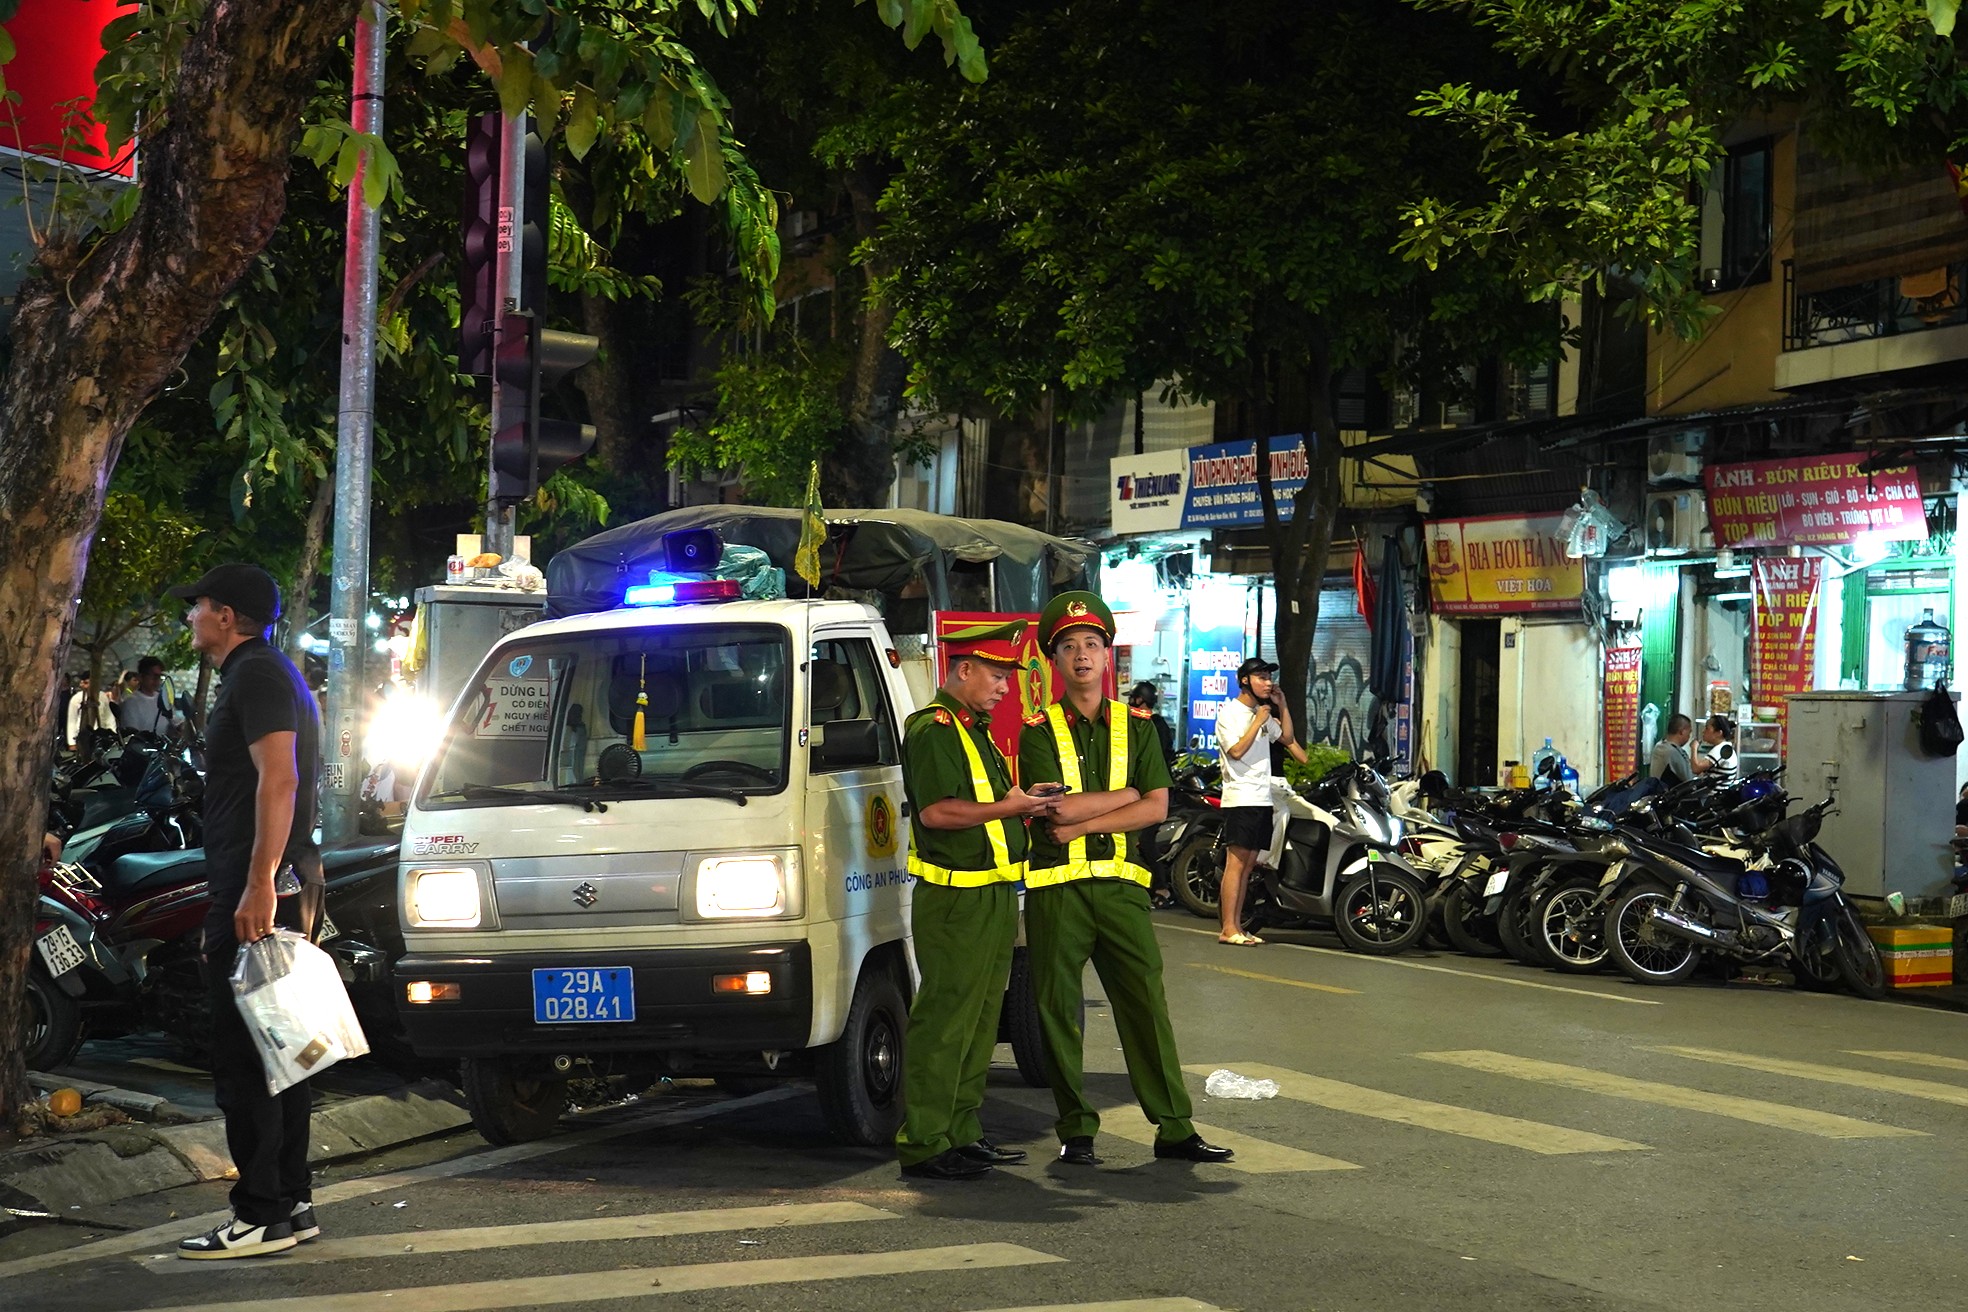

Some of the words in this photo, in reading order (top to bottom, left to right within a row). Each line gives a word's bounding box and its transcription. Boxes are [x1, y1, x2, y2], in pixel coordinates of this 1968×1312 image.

[1239, 442, 1257, 484] PHẨ
[1765, 466, 1799, 483] BÚN
[1803, 461, 1841, 481] RIÊU
[1885, 480, 1904, 501] CHẢ
[1905, 481, 1918, 499] CÁ
[1713, 494, 1742, 516] BÚN
[1745, 491, 1778, 515] RIÊU
[1815, 509, 1834, 527] VIÊN
[1723, 520, 1749, 542] TÓP
[1467, 542, 1490, 571] BIA
[1523, 532, 1546, 567] HÀ
[1496, 575, 1523, 597] VIỆT
[1527, 578, 1552, 593] HOA
[501, 684, 535, 696] DỪNG
[512, 699, 525, 708] CÓ
[501, 722, 526, 732] CHẾT
[504, 712, 530, 720] NGUY
[413, 842, 480, 856] CARRY
[845, 871, 872, 892] CÔNG
[875, 871, 887, 888] AN
[50, 944, 85, 975] 136.33
[561, 970, 604, 994] 29A
[545, 996, 621, 1020] 028.41
